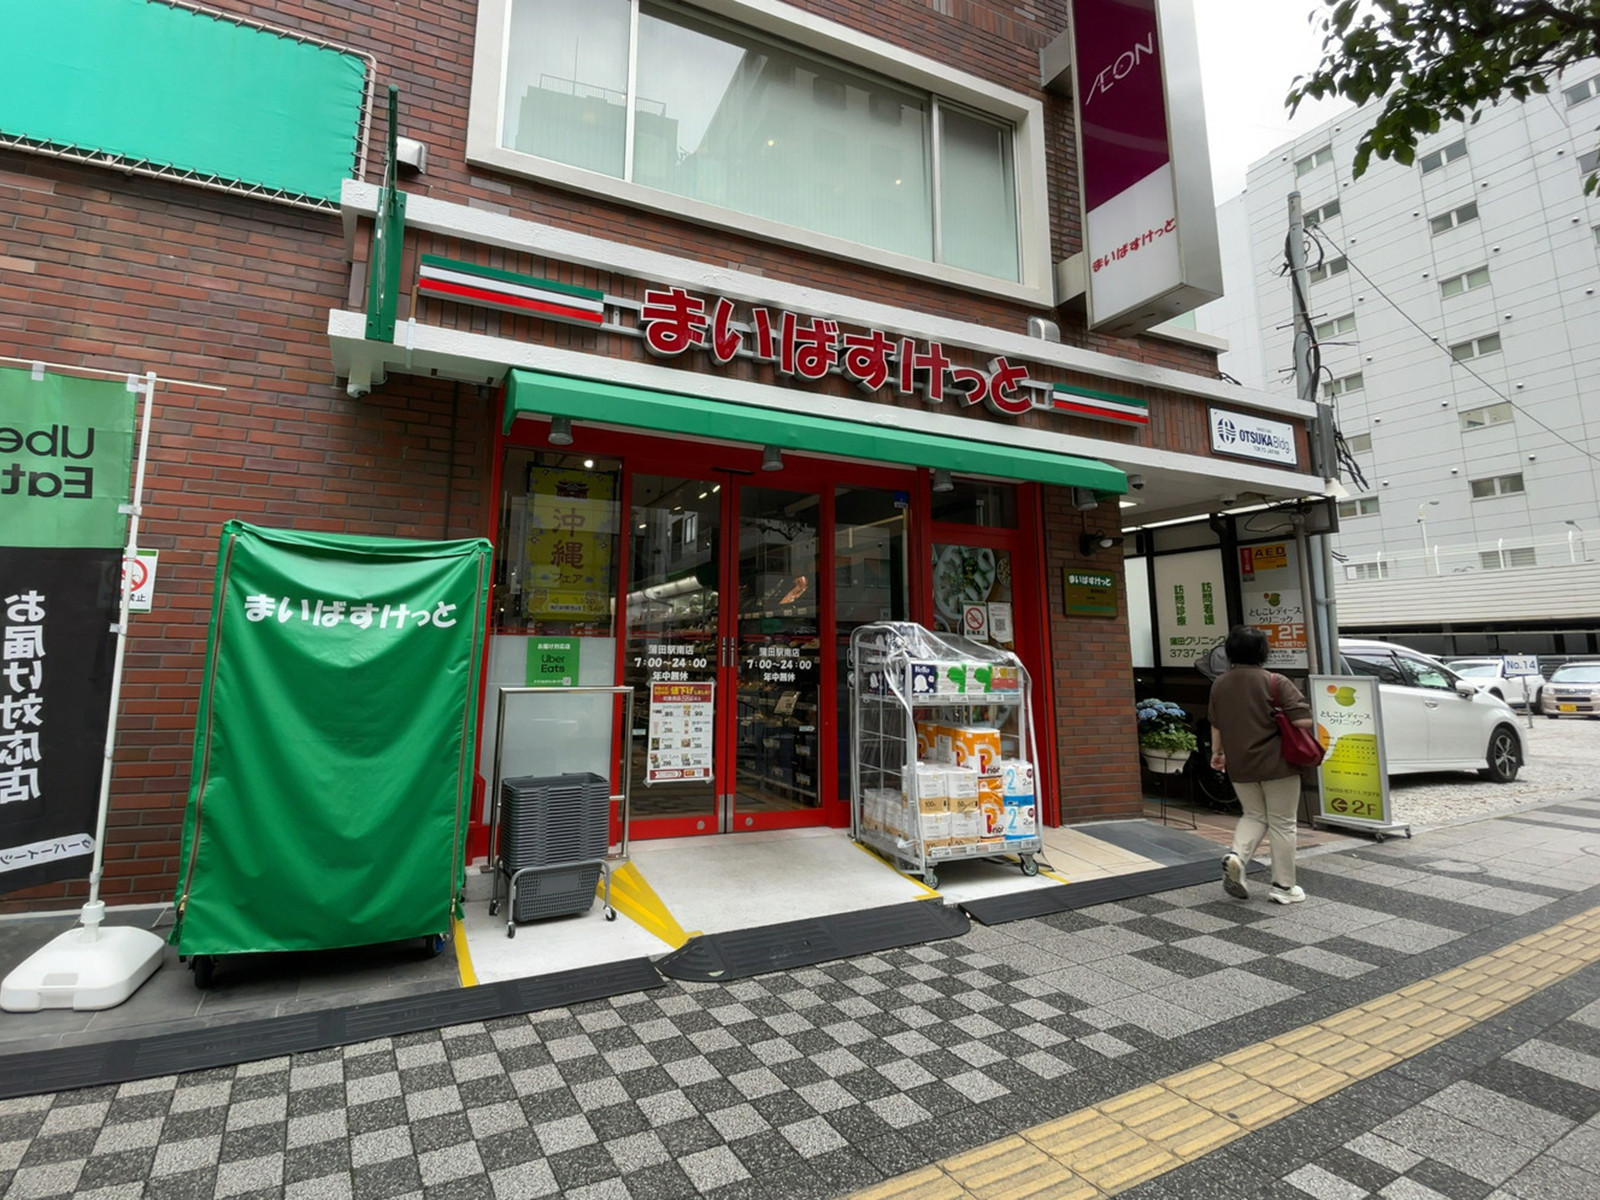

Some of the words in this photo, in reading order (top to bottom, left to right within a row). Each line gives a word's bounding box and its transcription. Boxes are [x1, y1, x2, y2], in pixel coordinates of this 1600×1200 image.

[1091, 218, 1176, 273] まいばすけっと
[641, 286, 1033, 415] まいばすけっと
[1239, 429, 1274, 447] OTSUKA
[550, 507, 586, 569] 沖縄
[1255, 546, 1286, 559] AED
[1069, 575, 1112, 587] まいばすけっと
[244, 594, 457, 630] まいばすけっと
[1248, 606, 1302, 617] としこレディース
[1259, 616, 1293, 624] クリニック
[1278, 624, 1304, 640] 2F
[541, 654, 565, 663] Uber
[1170, 648, 1210, 658] 3737-6
[541, 664, 565, 673] Eats
[1507, 660, 1536, 670] No.14
[652, 671, 689, 681] 年中無休
[763, 673, 796, 682] 年中無休
[1320, 711, 1371, 719] としこレディース
[1329, 718, 1363, 726] クリニック
[978, 748, 1001, 775] Prior
[1351, 799, 1377, 816] 2F
[984, 807, 1005, 835] Prior
